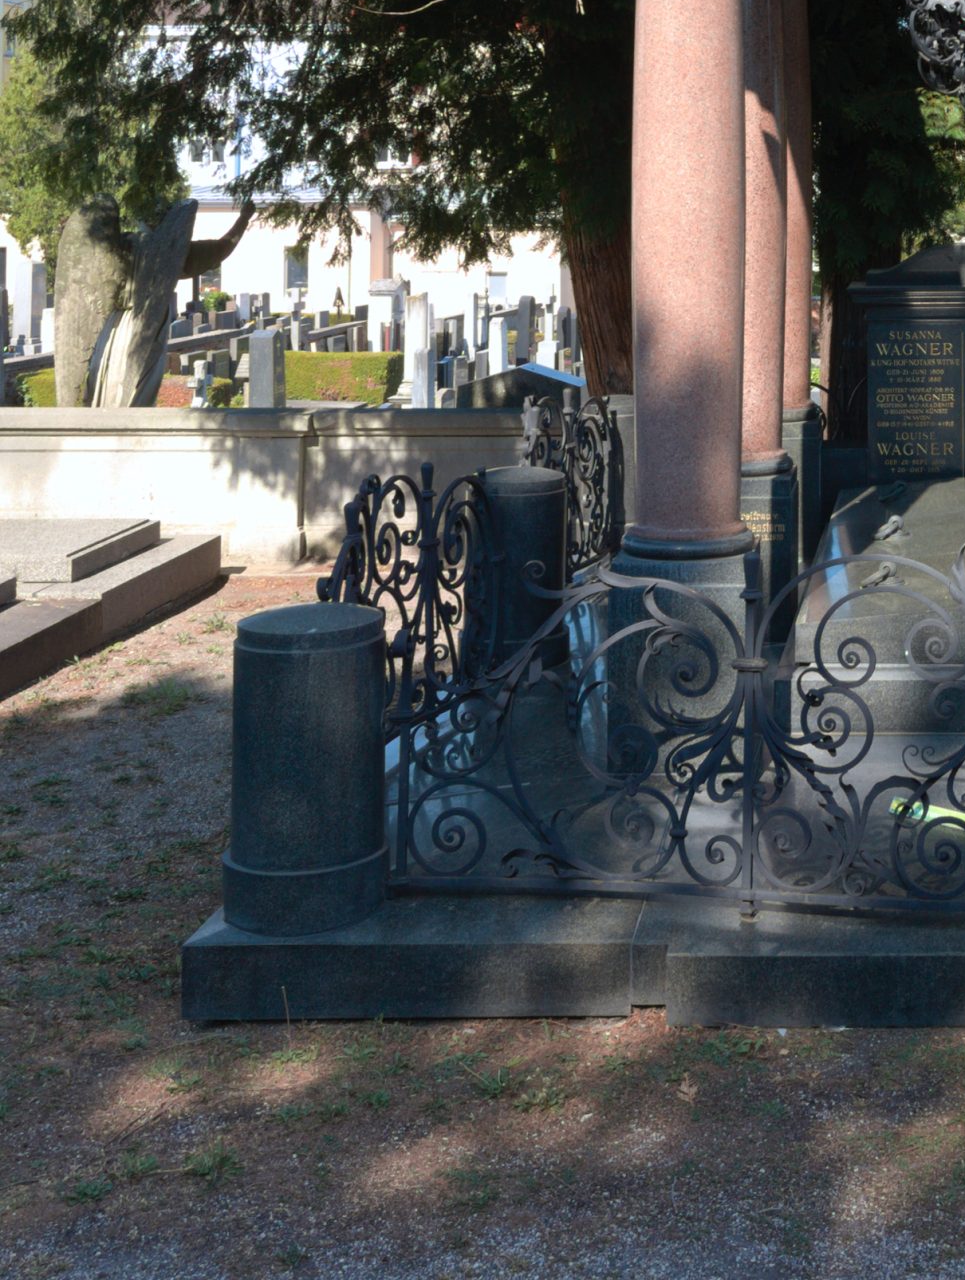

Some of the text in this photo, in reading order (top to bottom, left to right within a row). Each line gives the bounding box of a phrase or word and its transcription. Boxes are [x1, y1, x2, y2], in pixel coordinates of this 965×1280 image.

[889, 330, 943, 340] SUSANNA
[876, 342, 954, 356] WAGNER
[876, 393, 955, 402] OTTO WAGNER
[896, 431, 937, 440] LOUISE
[877, 441, 954, 456] WAGNER
